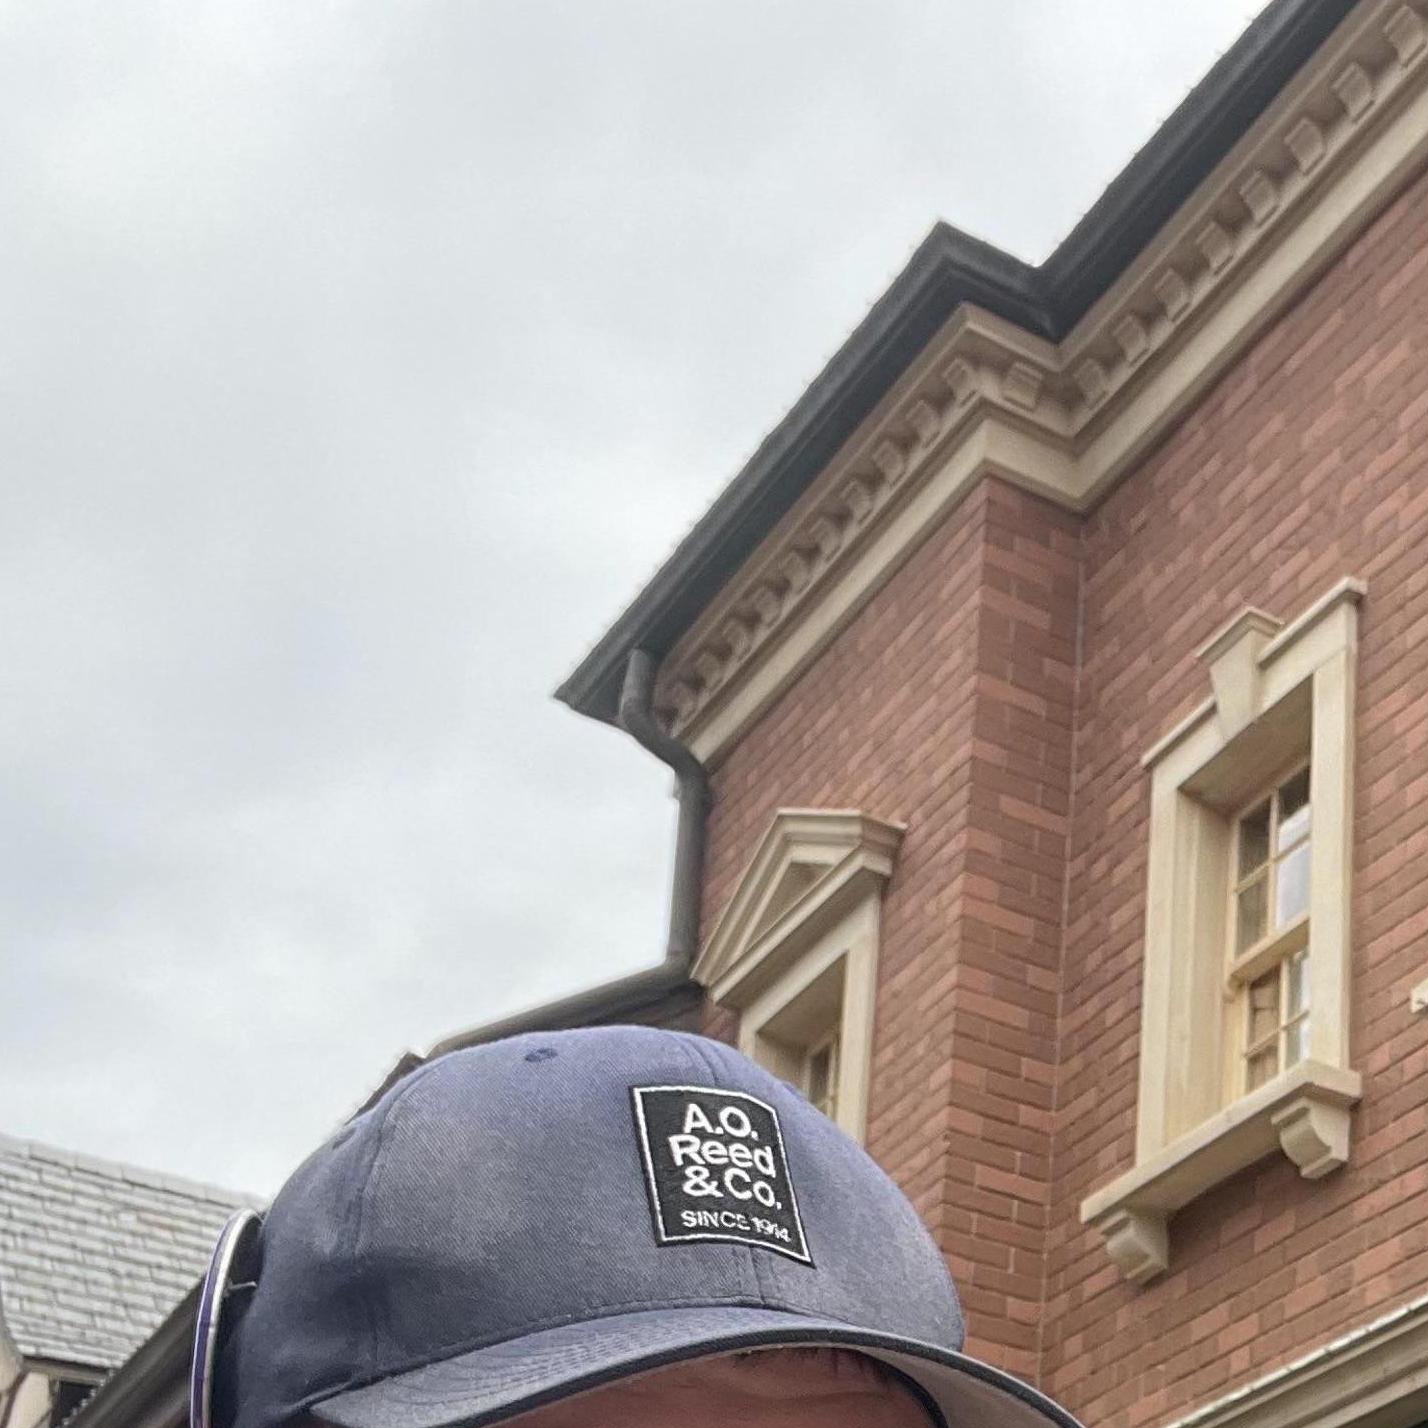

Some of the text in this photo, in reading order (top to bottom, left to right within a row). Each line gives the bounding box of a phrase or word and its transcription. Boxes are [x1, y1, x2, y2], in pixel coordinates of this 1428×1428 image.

[682, 1102, 759, 1141] A.O.
[667, 1133, 777, 1179] Reed
[680, 1210, 752, 1232] SINCE
